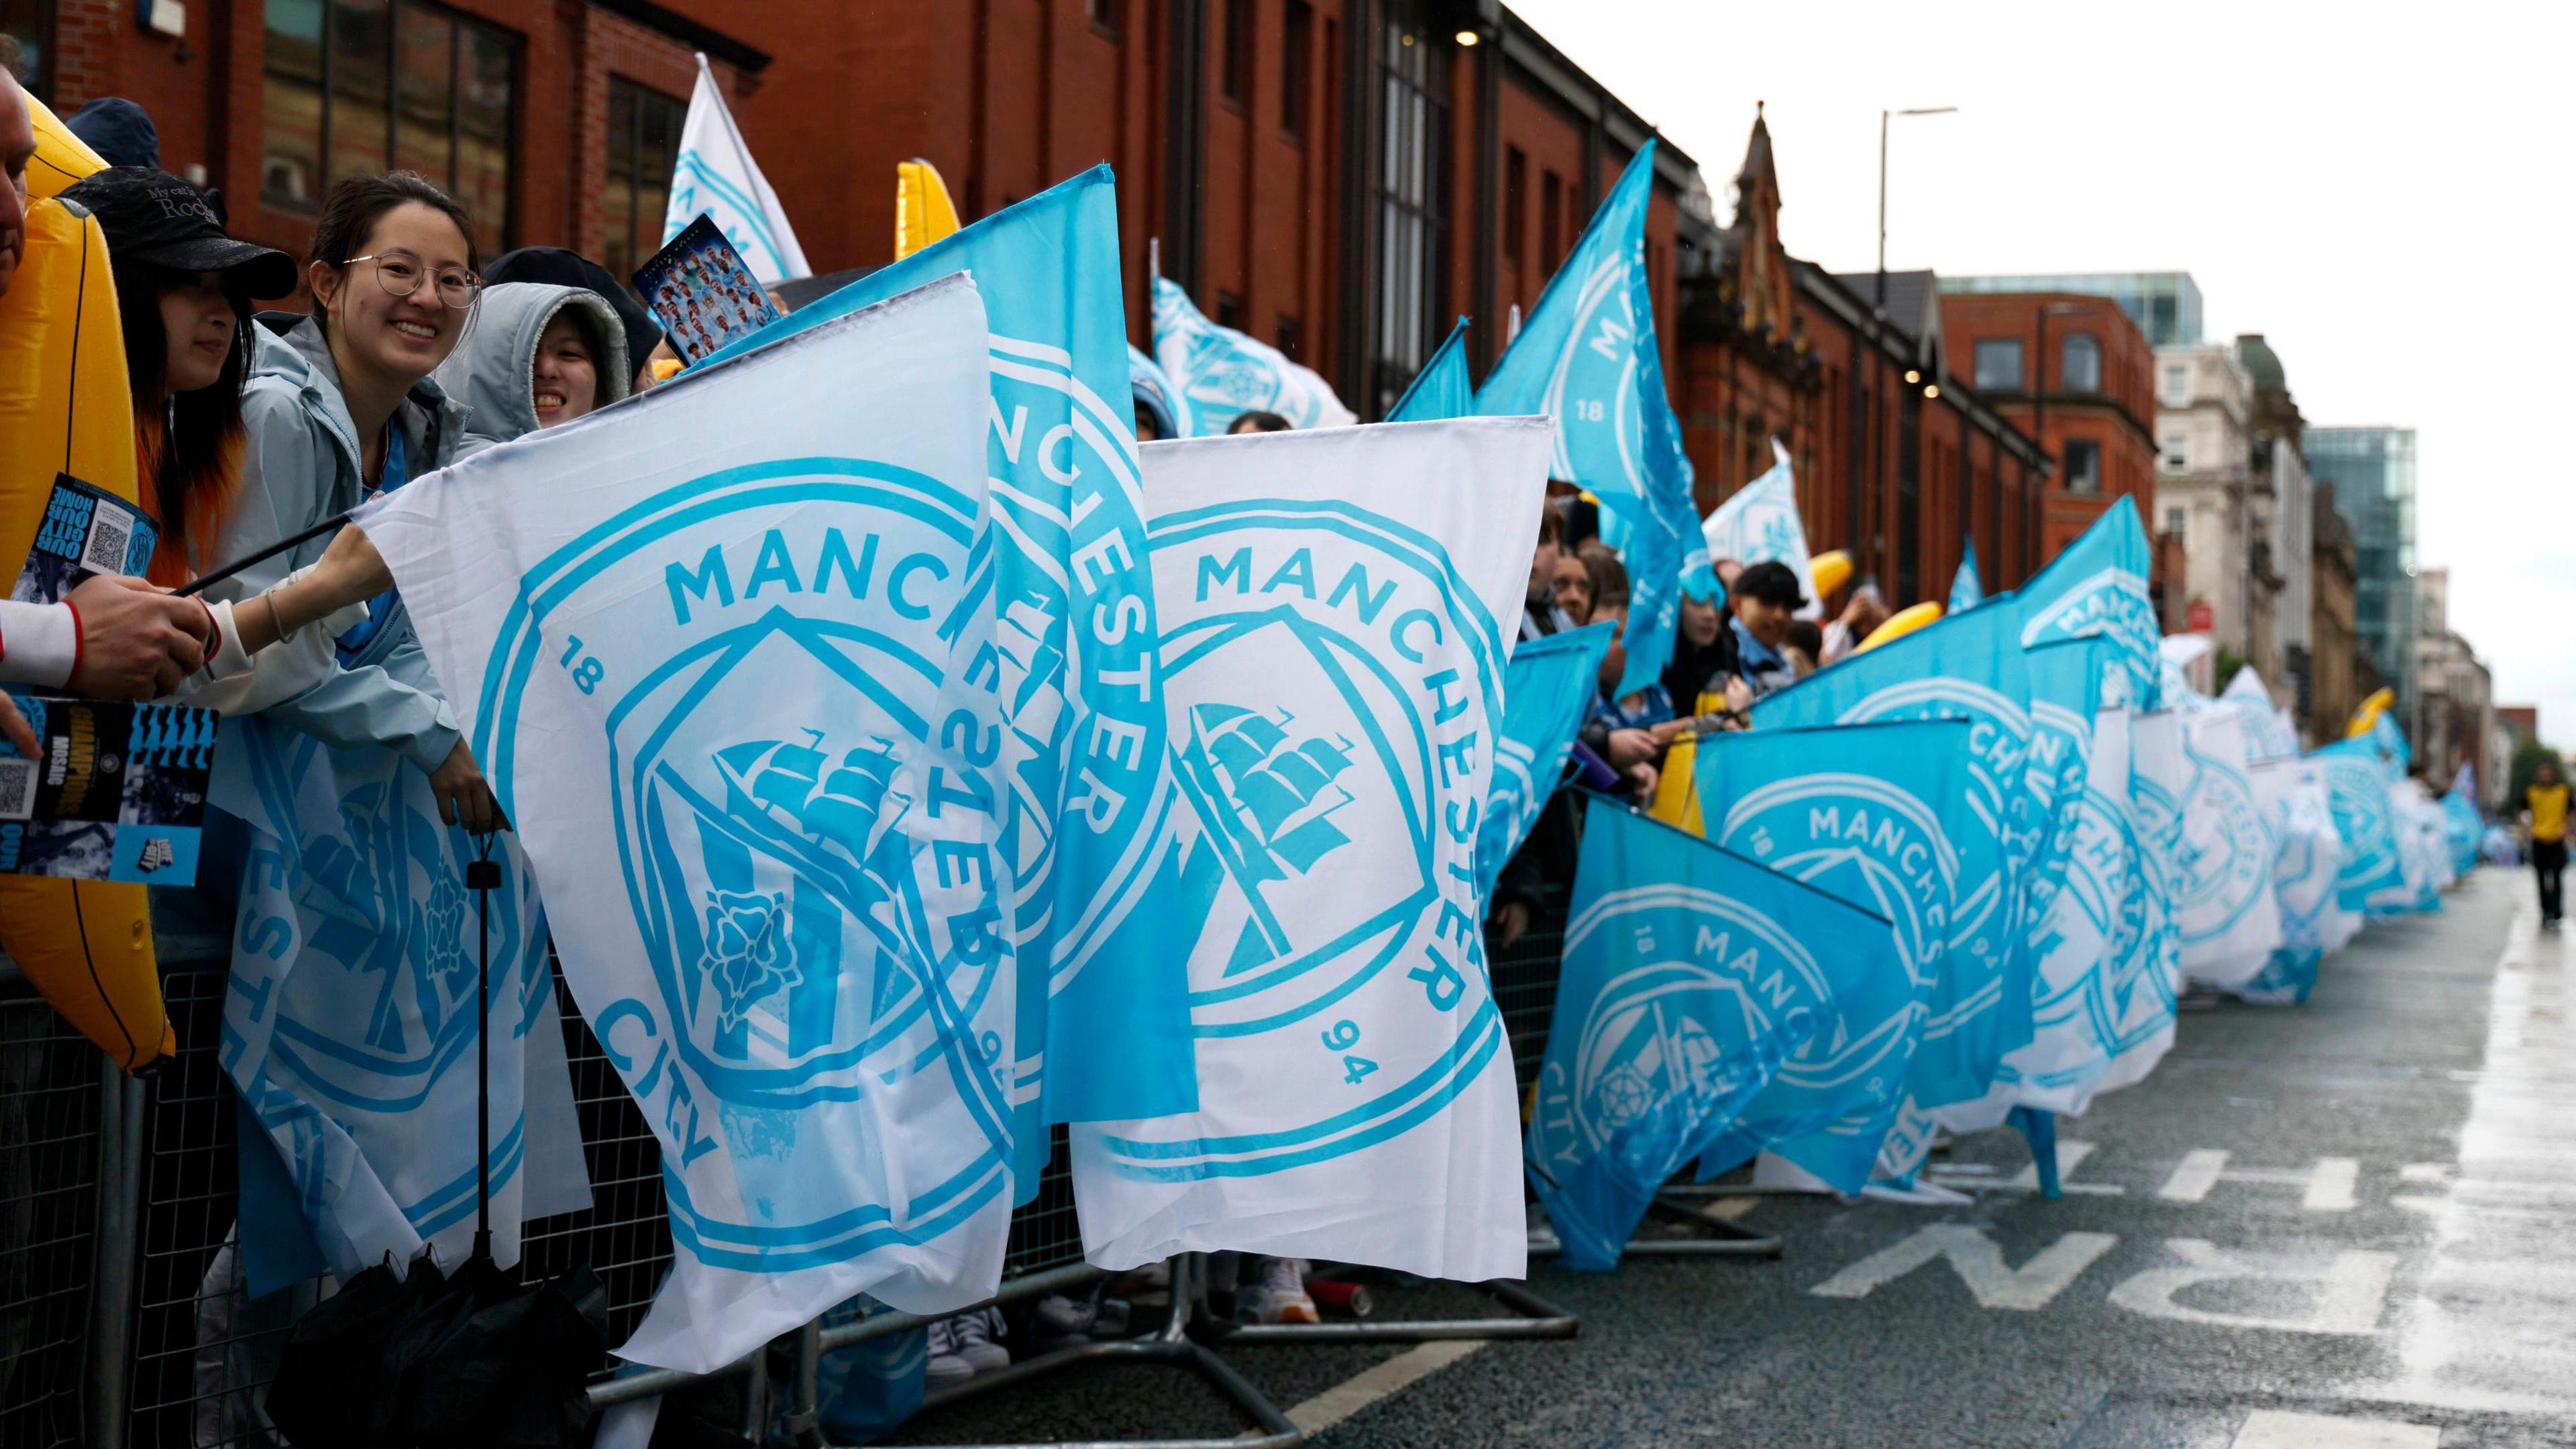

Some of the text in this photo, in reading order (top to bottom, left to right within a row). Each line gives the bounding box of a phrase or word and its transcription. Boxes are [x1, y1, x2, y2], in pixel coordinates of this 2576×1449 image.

[147, 189, 169, 199] My
[1576, 399, 1603, 422] 18
[54, 487, 94, 512] HOME
[40, 518, 85, 541] CITY
[48, 504, 89, 529] OUR
[37, 537, 80, 559] OUR
[559, 635, 604, 696] 18
[47, 735, 70, 786] MOSAIC
[1195, 546, 1477, 1012] MANCHESTER
[1748, 825, 1774, 857] 18
[1634, 925, 1656, 954] 18
[1321, 1019, 1379, 1086] 94
[1546, 1061, 1582, 1165] CITY
